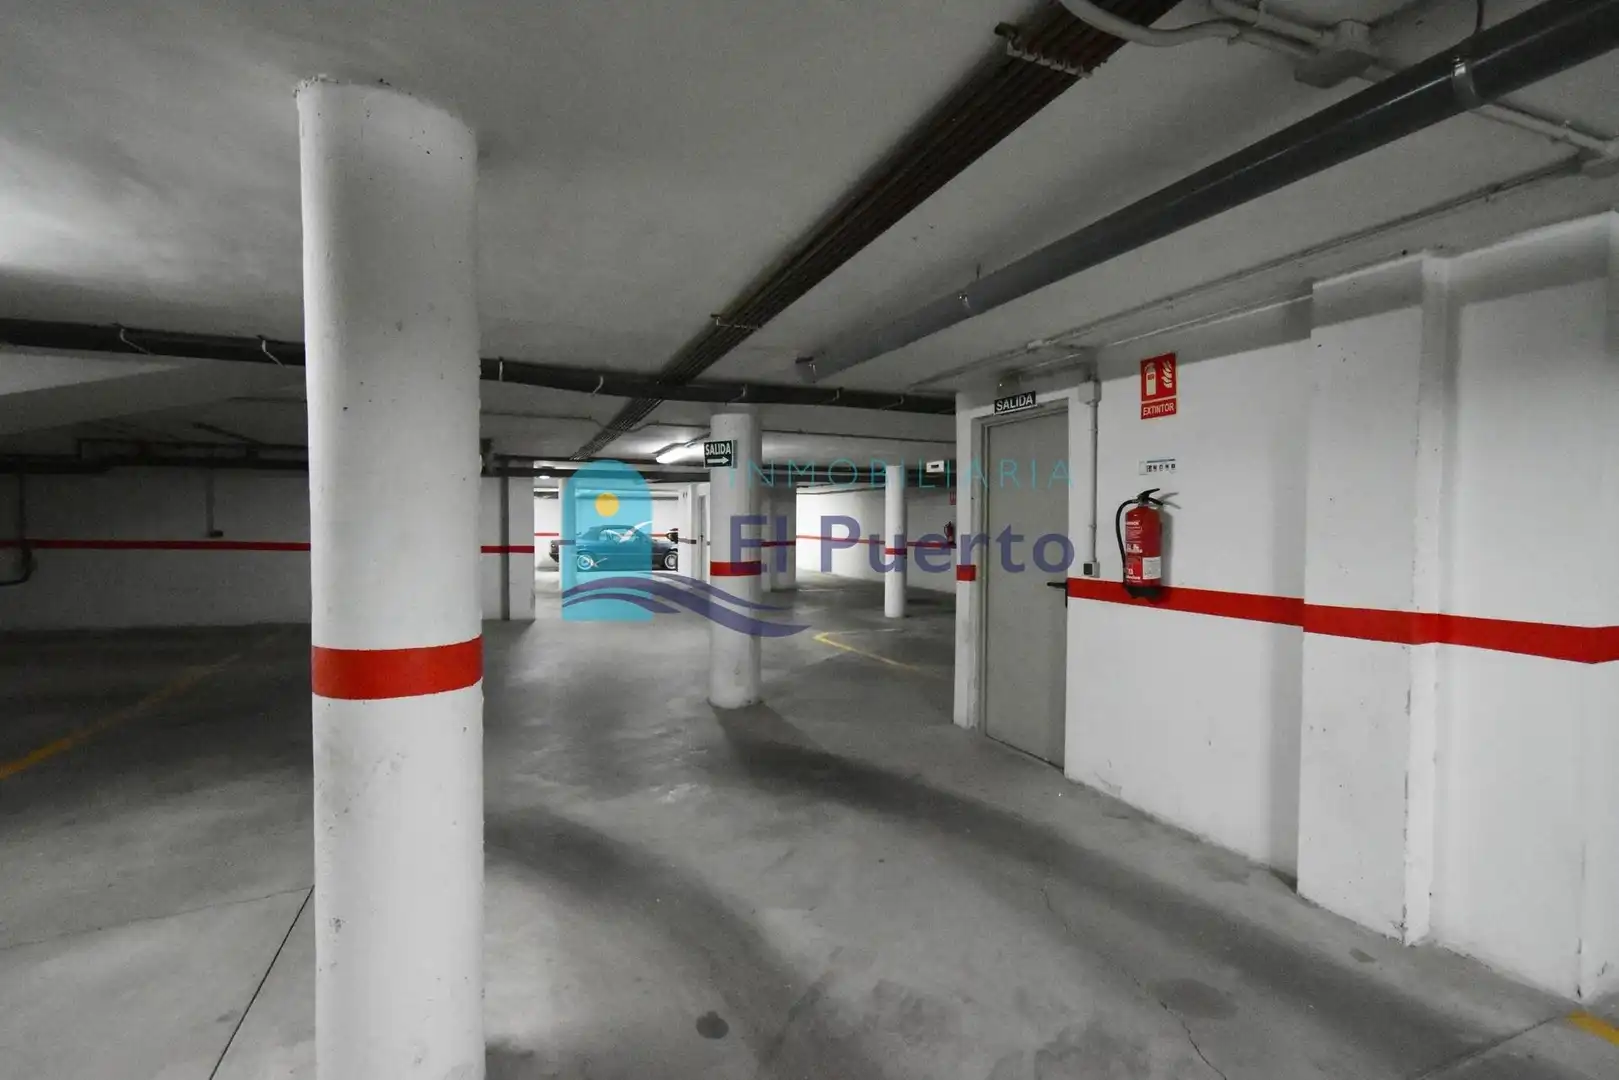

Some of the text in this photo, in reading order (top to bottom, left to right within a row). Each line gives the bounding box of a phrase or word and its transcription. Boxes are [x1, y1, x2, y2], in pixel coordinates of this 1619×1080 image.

[995, 393, 1033, 411] SALIDA
[1143, 402, 1175, 417] EXTINTOR
[705, 442, 732, 456] SALIDA
